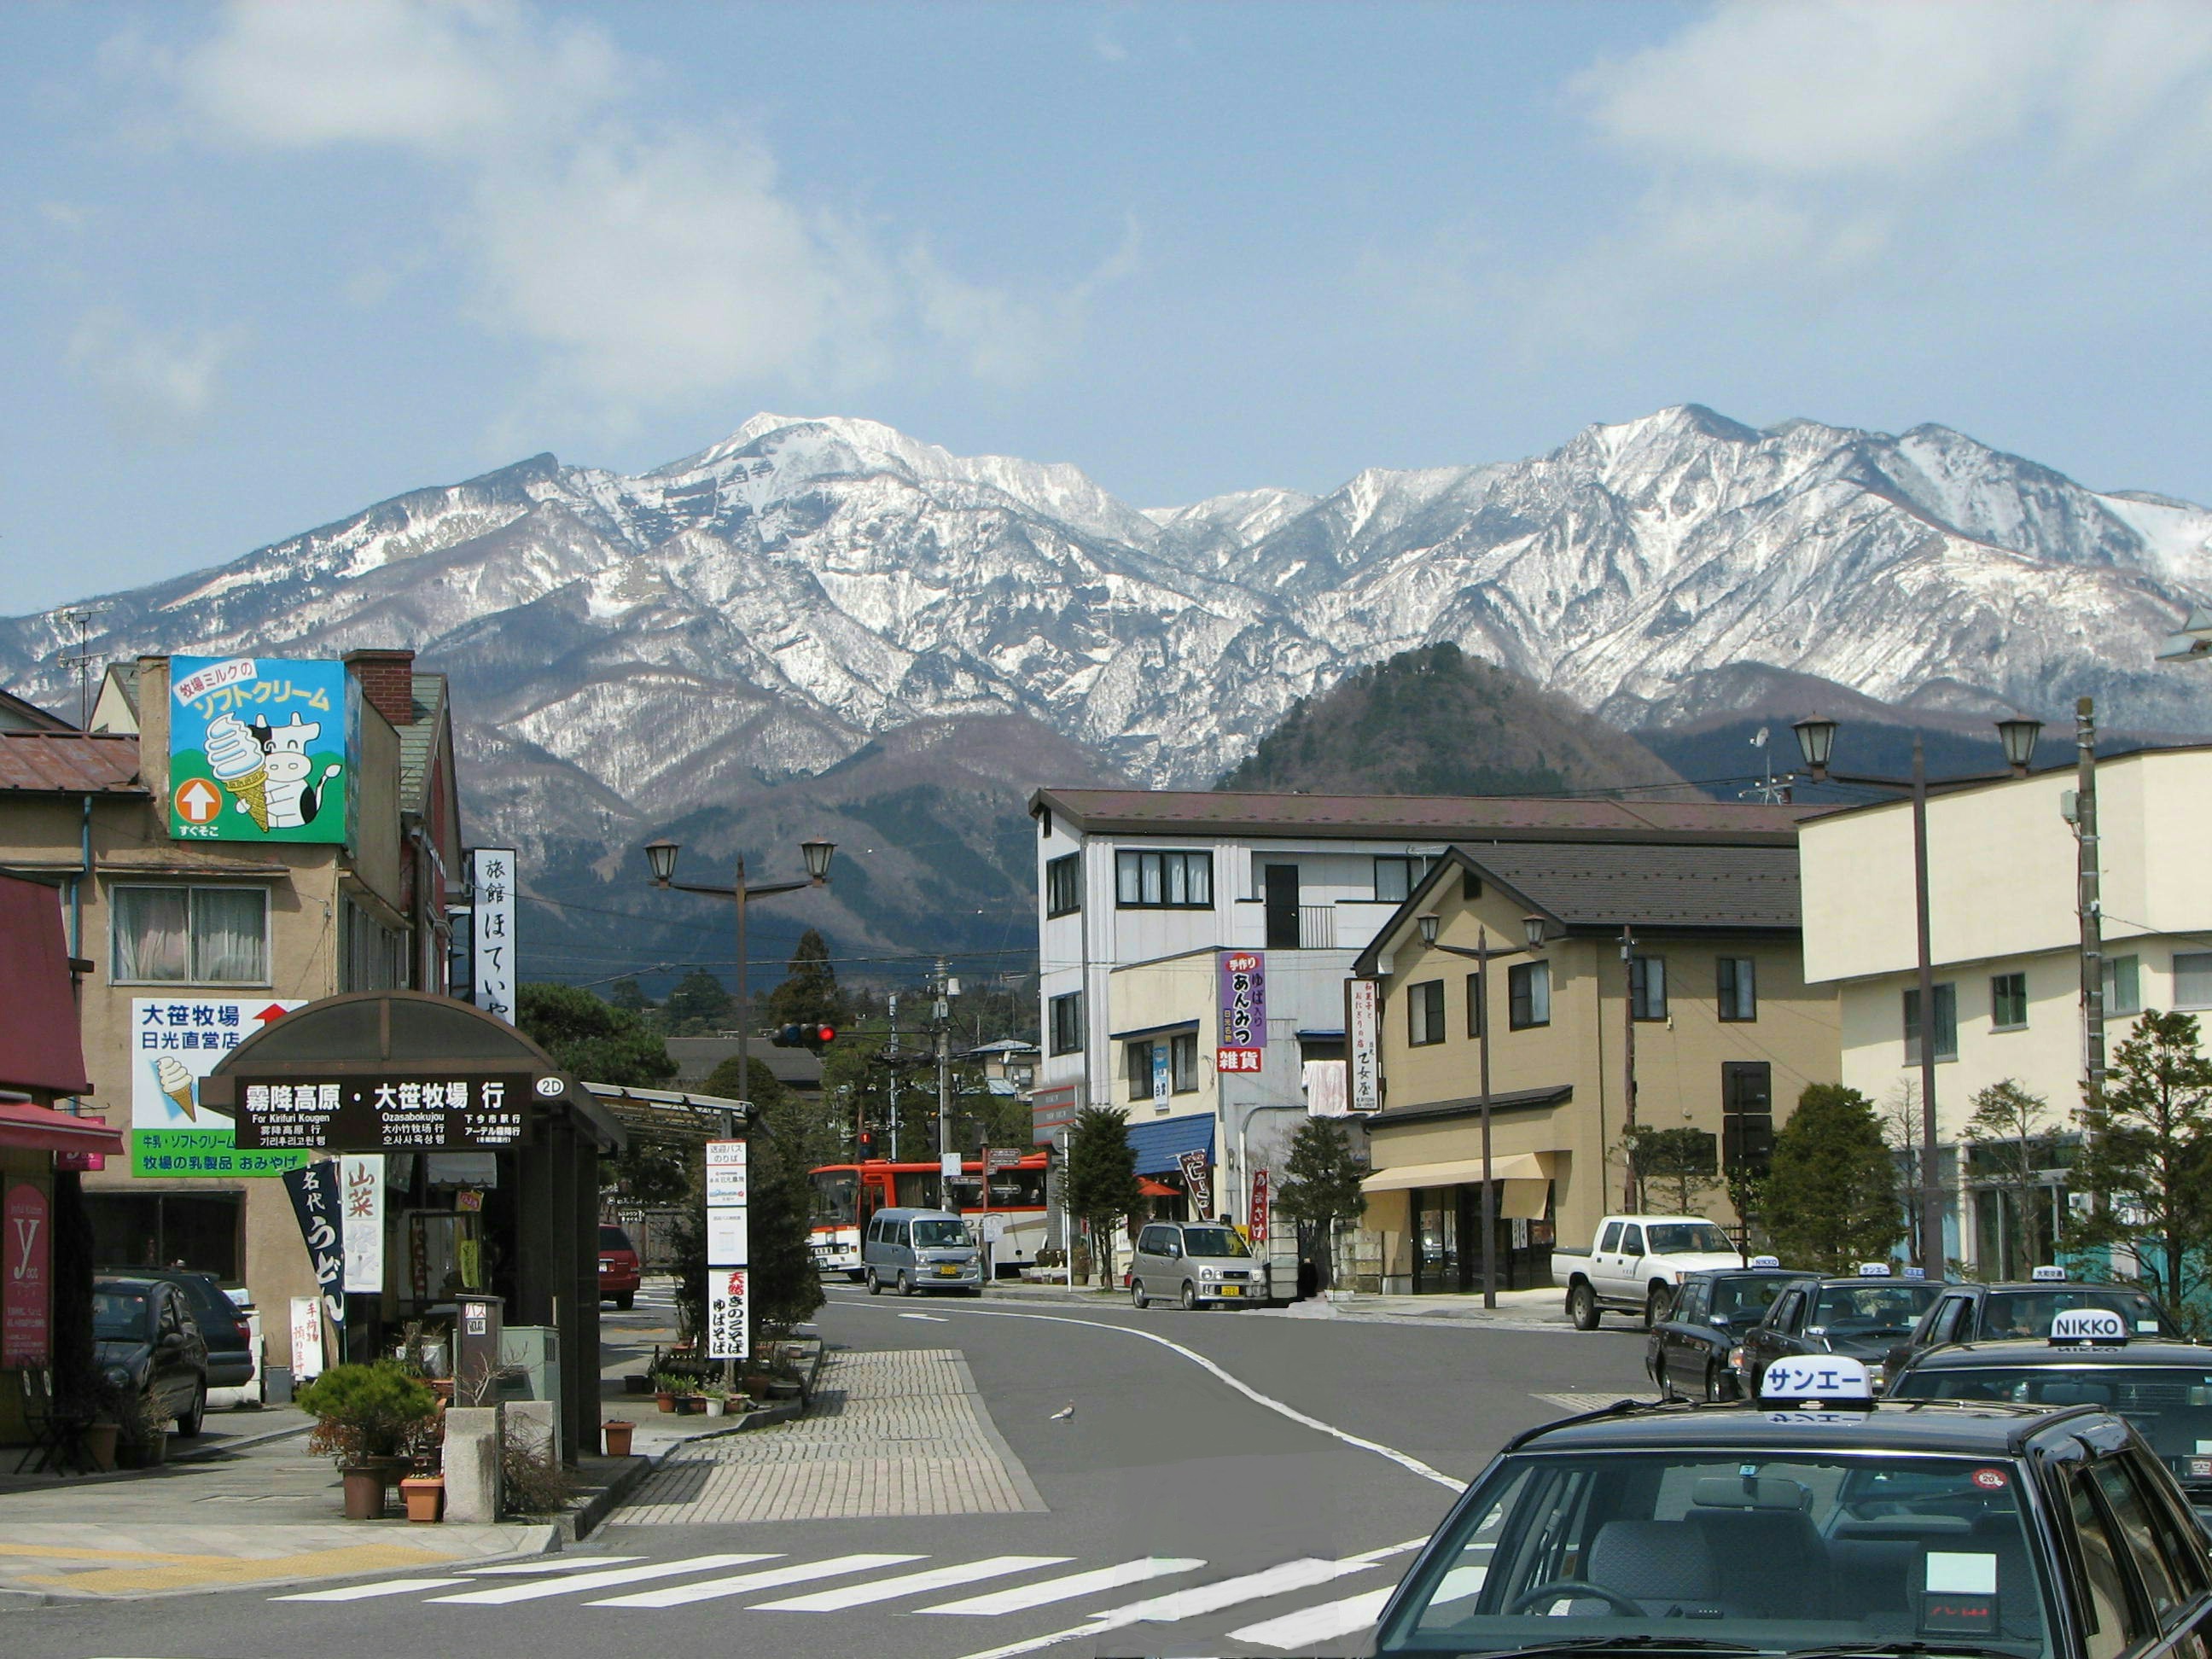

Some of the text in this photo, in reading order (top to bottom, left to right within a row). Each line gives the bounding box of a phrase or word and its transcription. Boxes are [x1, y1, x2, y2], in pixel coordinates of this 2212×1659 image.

[179, 661, 253, 698] 牧場ミルクの
[194, 679, 330, 719] ソフトクリーム
[178, 825, 219, 837] すぐそこ
[1229, 957, 1257, 971] 手作り
[1232, 973, 1252, 1046] あんみつ
[1251, 973, 1264, 1027] ゆば入り
[142, 1004, 240, 1027] 大笹牧場
[142, 1031, 240, 1051] 日光直営店
[1219, 1051, 1259, 1070] 雑貨
[542, 1080, 562, 1093] 2D
[252, 1114, 330, 1125] For Kirifuri Kougen
[381, 1112, 445, 1123] Ozasabokujou
[143, 1155, 299, 1171] 牧場の乳製品 おみやげ
[713, 1155, 738, 1163] のりば
[347, 1161, 375, 1218] 山菜
[1251, 1173, 1266, 1238] あまさけ
[713, 1298, 725, 1354] ゆばそば
[2057, 1318, 2118, 1335] NIKKO
[1767, 1368, 1862, 1392] サンエー
